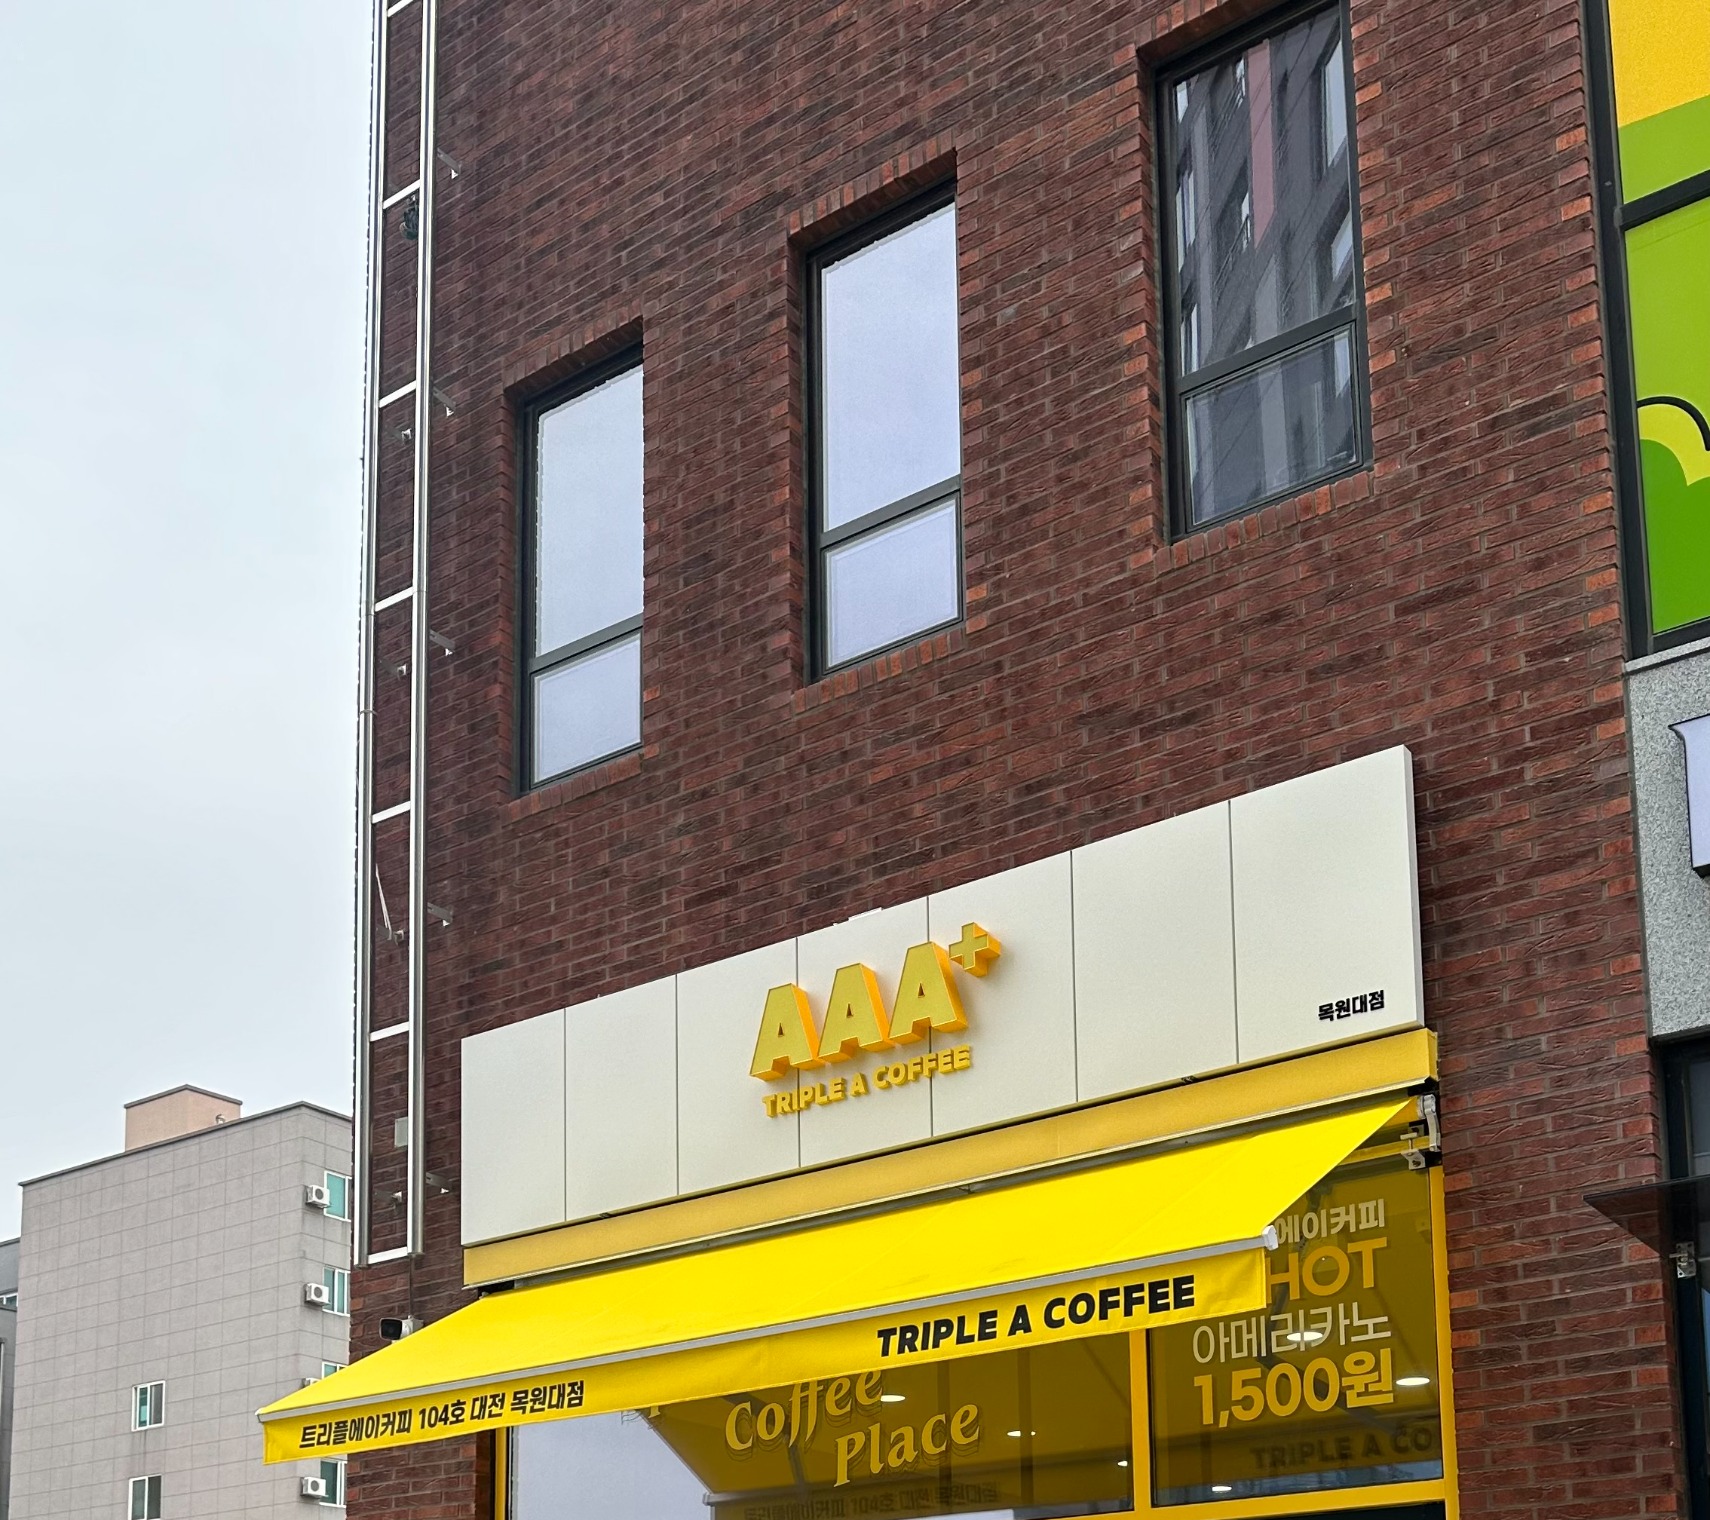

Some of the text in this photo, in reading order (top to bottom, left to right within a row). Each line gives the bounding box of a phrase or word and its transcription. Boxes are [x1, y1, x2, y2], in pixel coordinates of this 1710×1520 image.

[1318, 989, 1385, 1022] 목원대점
[762, 1045, 972, 1119] TRIPLE A COFFEE
[876, 1275, 1195, 1358] TRIPLE A COFFEE
[1192, 1301, 1393, 1364] 아메리카노
[299, 1409, 413, 1449] 트리플에이커피
[418, 1399, 467, 1431] 104호
[470, 1390, 506, 1421] 대전
[510, 1380, 586, 1415] 목원대점
[725, 1370, 883, 1451] Coffee
[1193, 1348, 1394, 1429] 1,500원
[834, 1404, 980, 1488] Place
